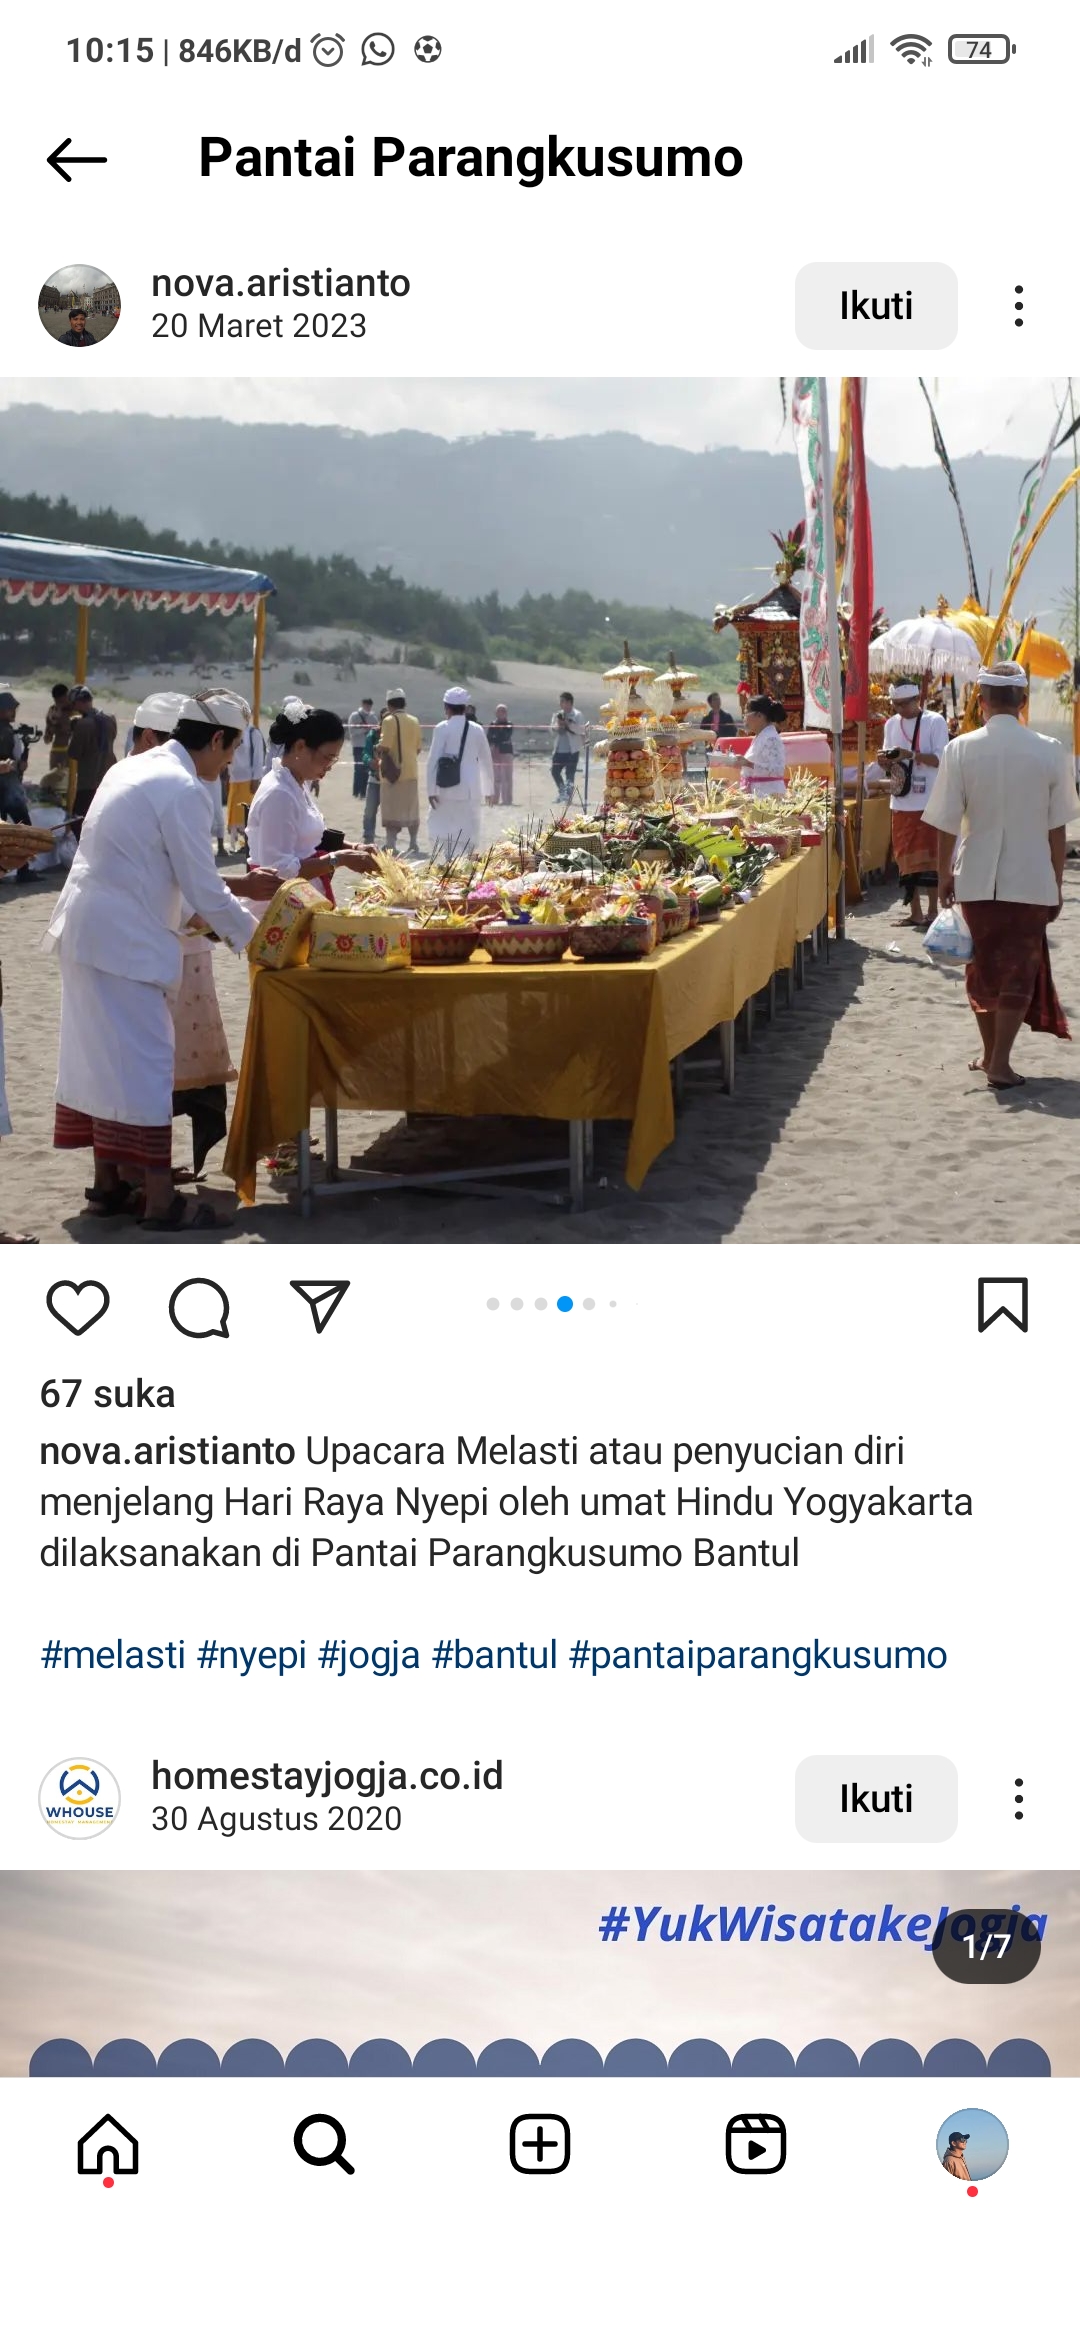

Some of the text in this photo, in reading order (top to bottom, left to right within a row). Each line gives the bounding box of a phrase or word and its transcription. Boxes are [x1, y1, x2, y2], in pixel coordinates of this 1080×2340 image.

[67, 37, 154, 63] 10:15
[178, 37, 301, 65] 846KB/d
[966, 41, 992, 59] 74
[201, 135, 742, 189] Pantai Parangkusumo
[152, 267, 411, 298] nova.aristianto
[841, 289, 913, 321] Ikuti
[152, 313, 366, 338] 20 Maret 2023
[40, 1377, 175, 1409] 67 suka
[40, 1434, 904, 1473] nova.aristianto Upacara Melasti atau penyucian diri
[40, 1485, 973, 1524] menjelang Hari Raya Nyepi oleh umat Hindu Yogyakarta
[40, 1536, 799, 1575] dilaksanakan di Pantai Parangkusumo Bantul
[40, 1638, 948, 1677] #melasti #nyepi #jogja #bantul #pantaiparangkusumo
[152, 1759, 503, 1798] homestayjogja.co.id
[46, 1807, 113, 1817] WHOUSE
[841, 1782, 913, 1814] Ikuti
[151, 1805, 402, 1838] 30 Agustus 2020
[598, 1904, 1048, 1952] #YukWisatakeJogja
[963, 1934, 1011, 1960] 1/7
